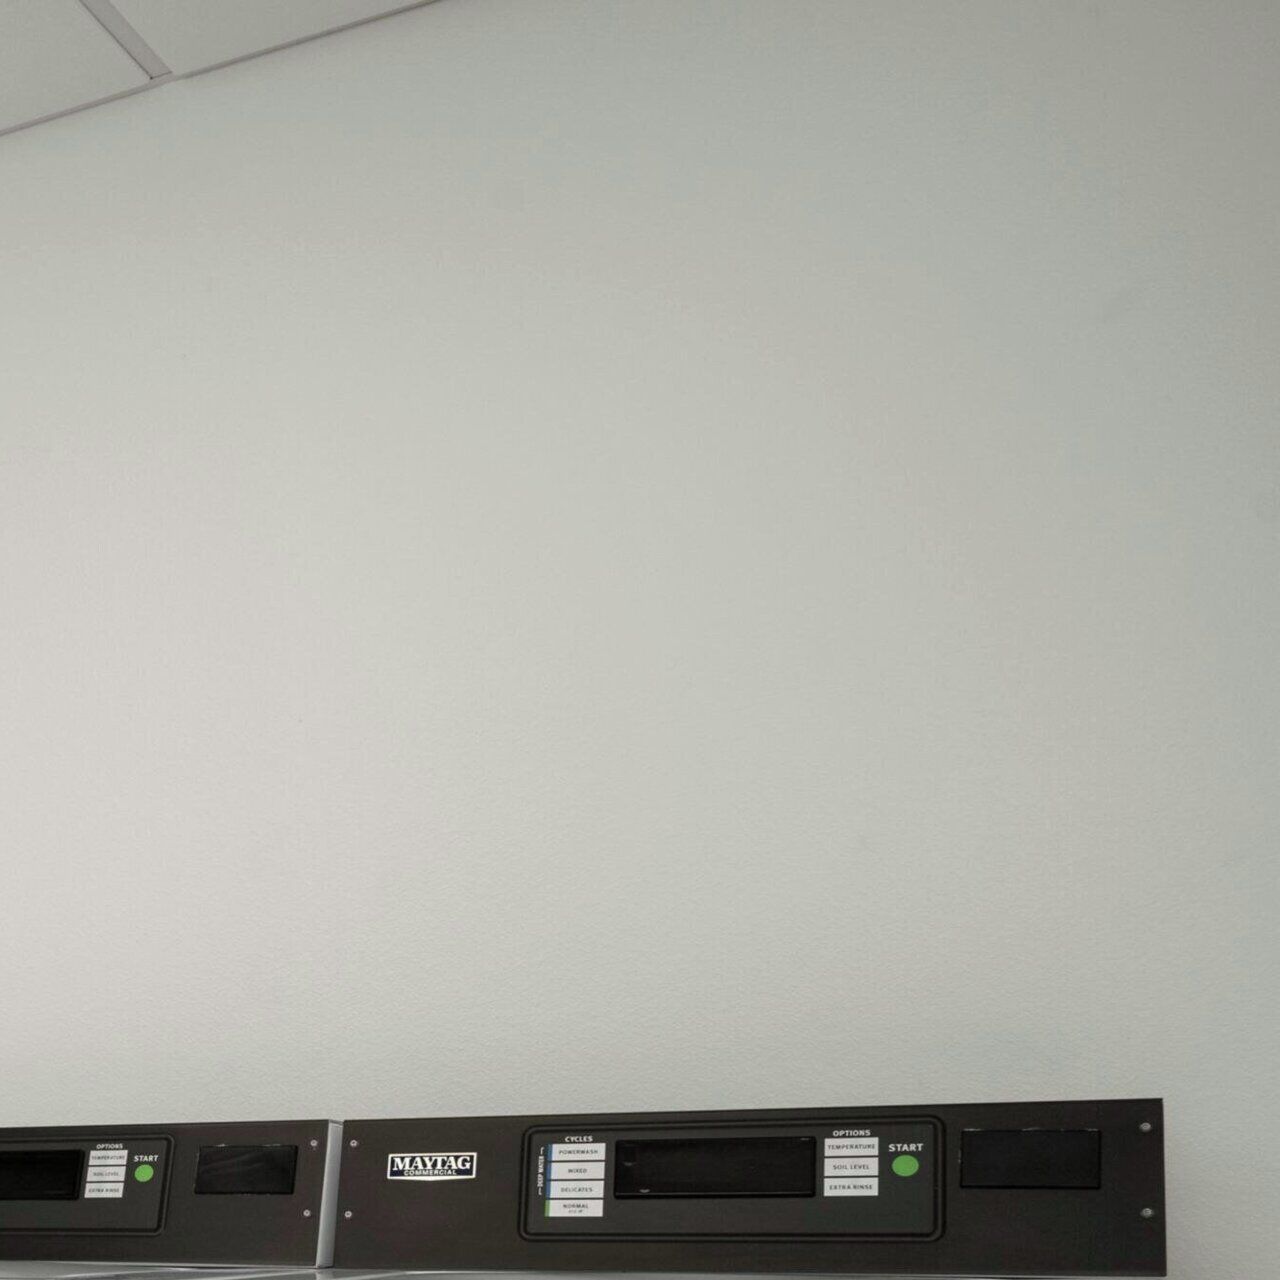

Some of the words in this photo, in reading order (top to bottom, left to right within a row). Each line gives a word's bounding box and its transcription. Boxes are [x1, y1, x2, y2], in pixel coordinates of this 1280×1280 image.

[832, 1129, 871, 1137] OPTIONS
[888, 1143, 924, 1152] START
[392, 1156, 471, 1171] MAYTAG
